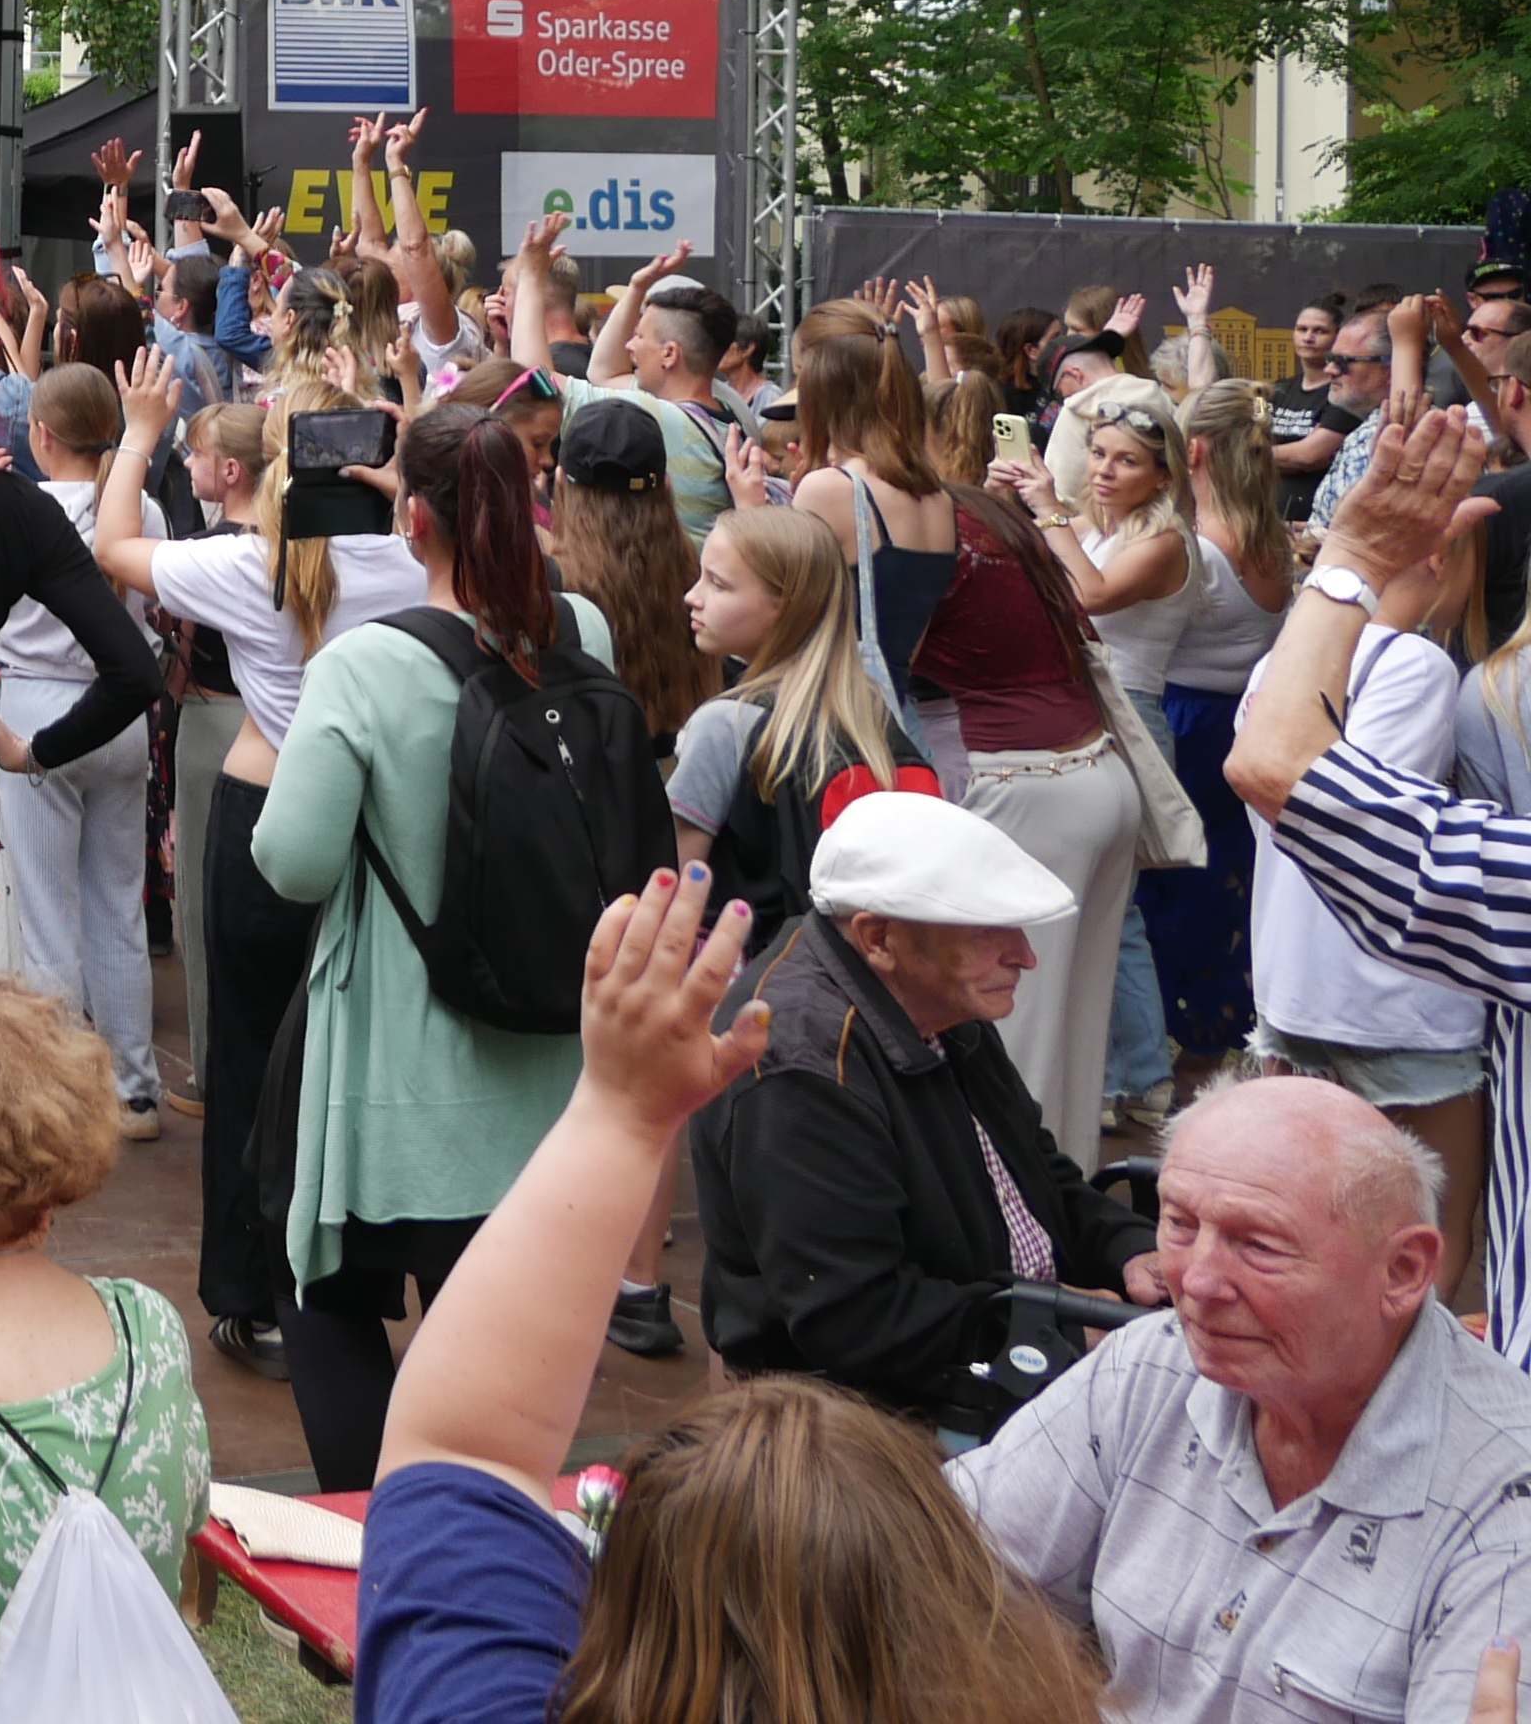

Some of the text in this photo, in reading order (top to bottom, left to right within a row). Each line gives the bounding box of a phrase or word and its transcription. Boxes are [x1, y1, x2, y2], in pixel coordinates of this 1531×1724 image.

[537, 11, 671, 46] Sparkasse
[537, 50, 686, 84] Oder-Spree
[543, 178, 676, 231] e.dis
